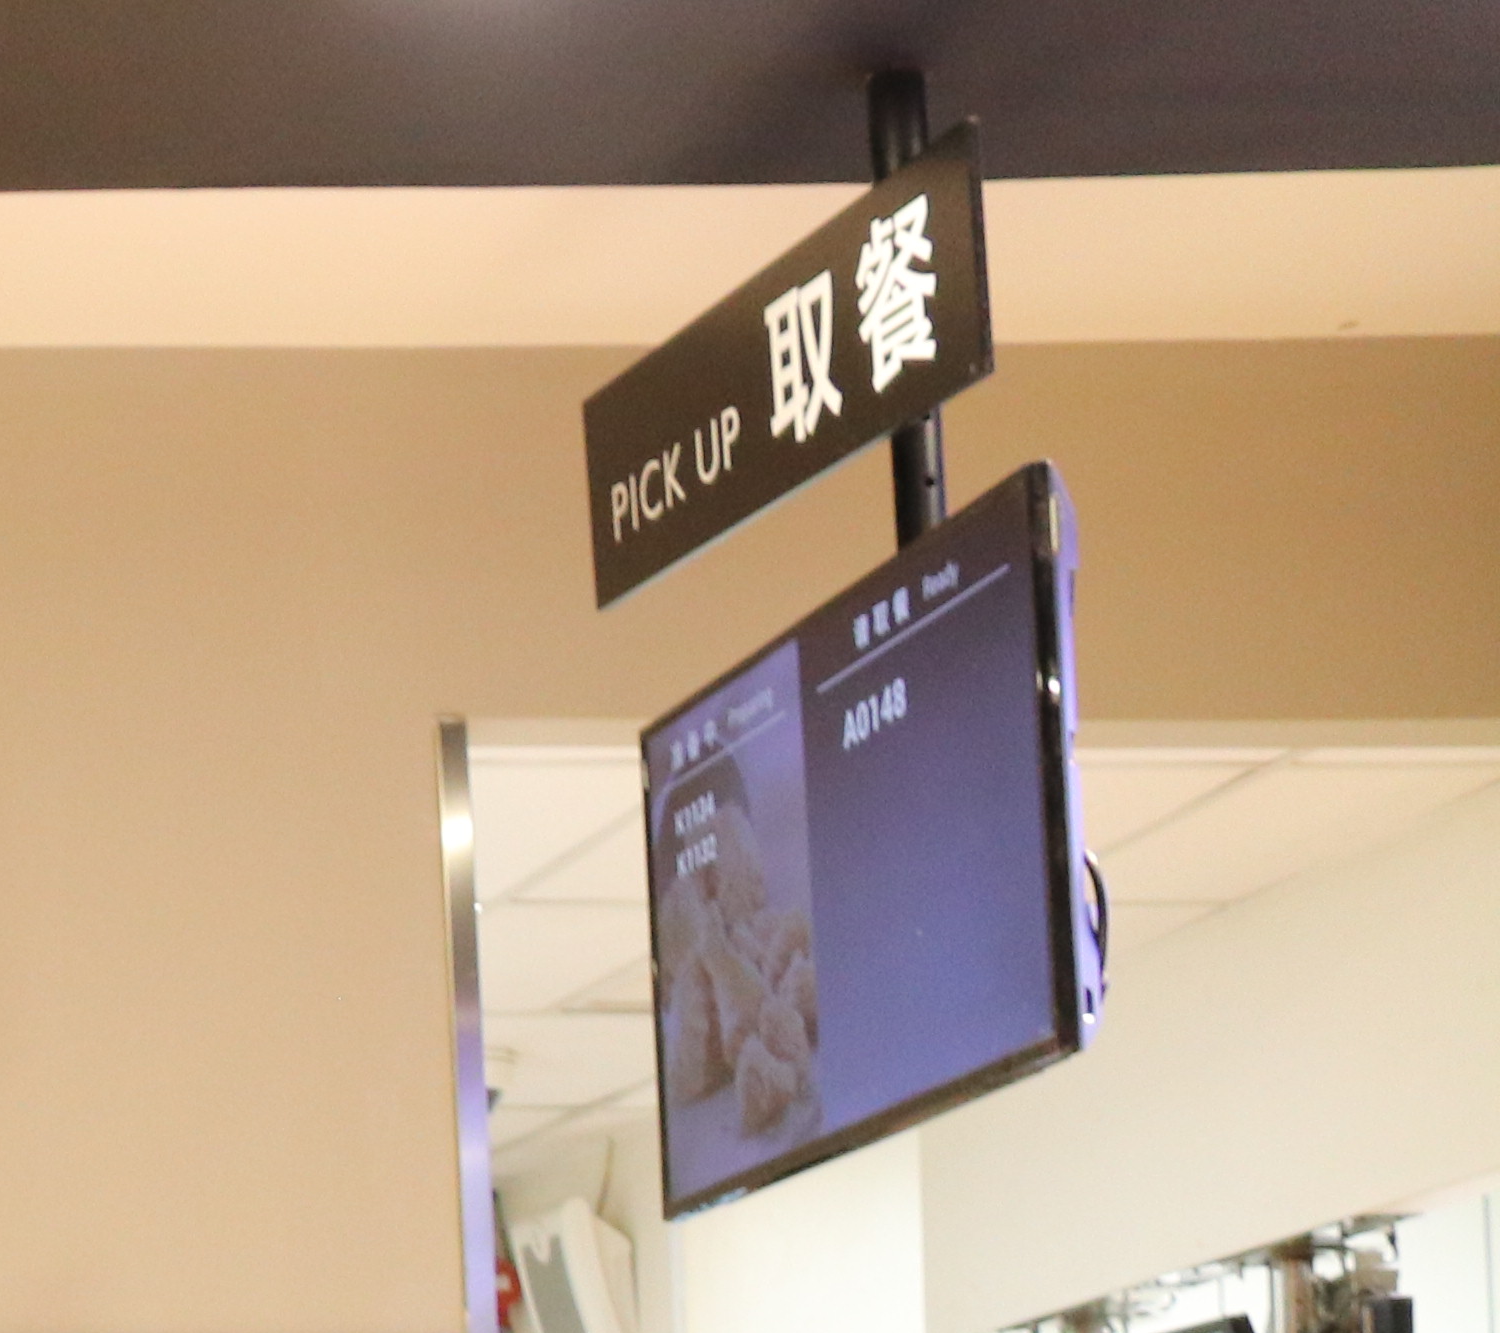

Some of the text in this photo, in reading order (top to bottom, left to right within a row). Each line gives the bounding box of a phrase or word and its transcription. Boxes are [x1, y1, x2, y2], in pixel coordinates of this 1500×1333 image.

[763, 192, 939, 445] 取餐
[610, 405, 742, 543] PICK UP
[843, 677, 908, 751] A0148
